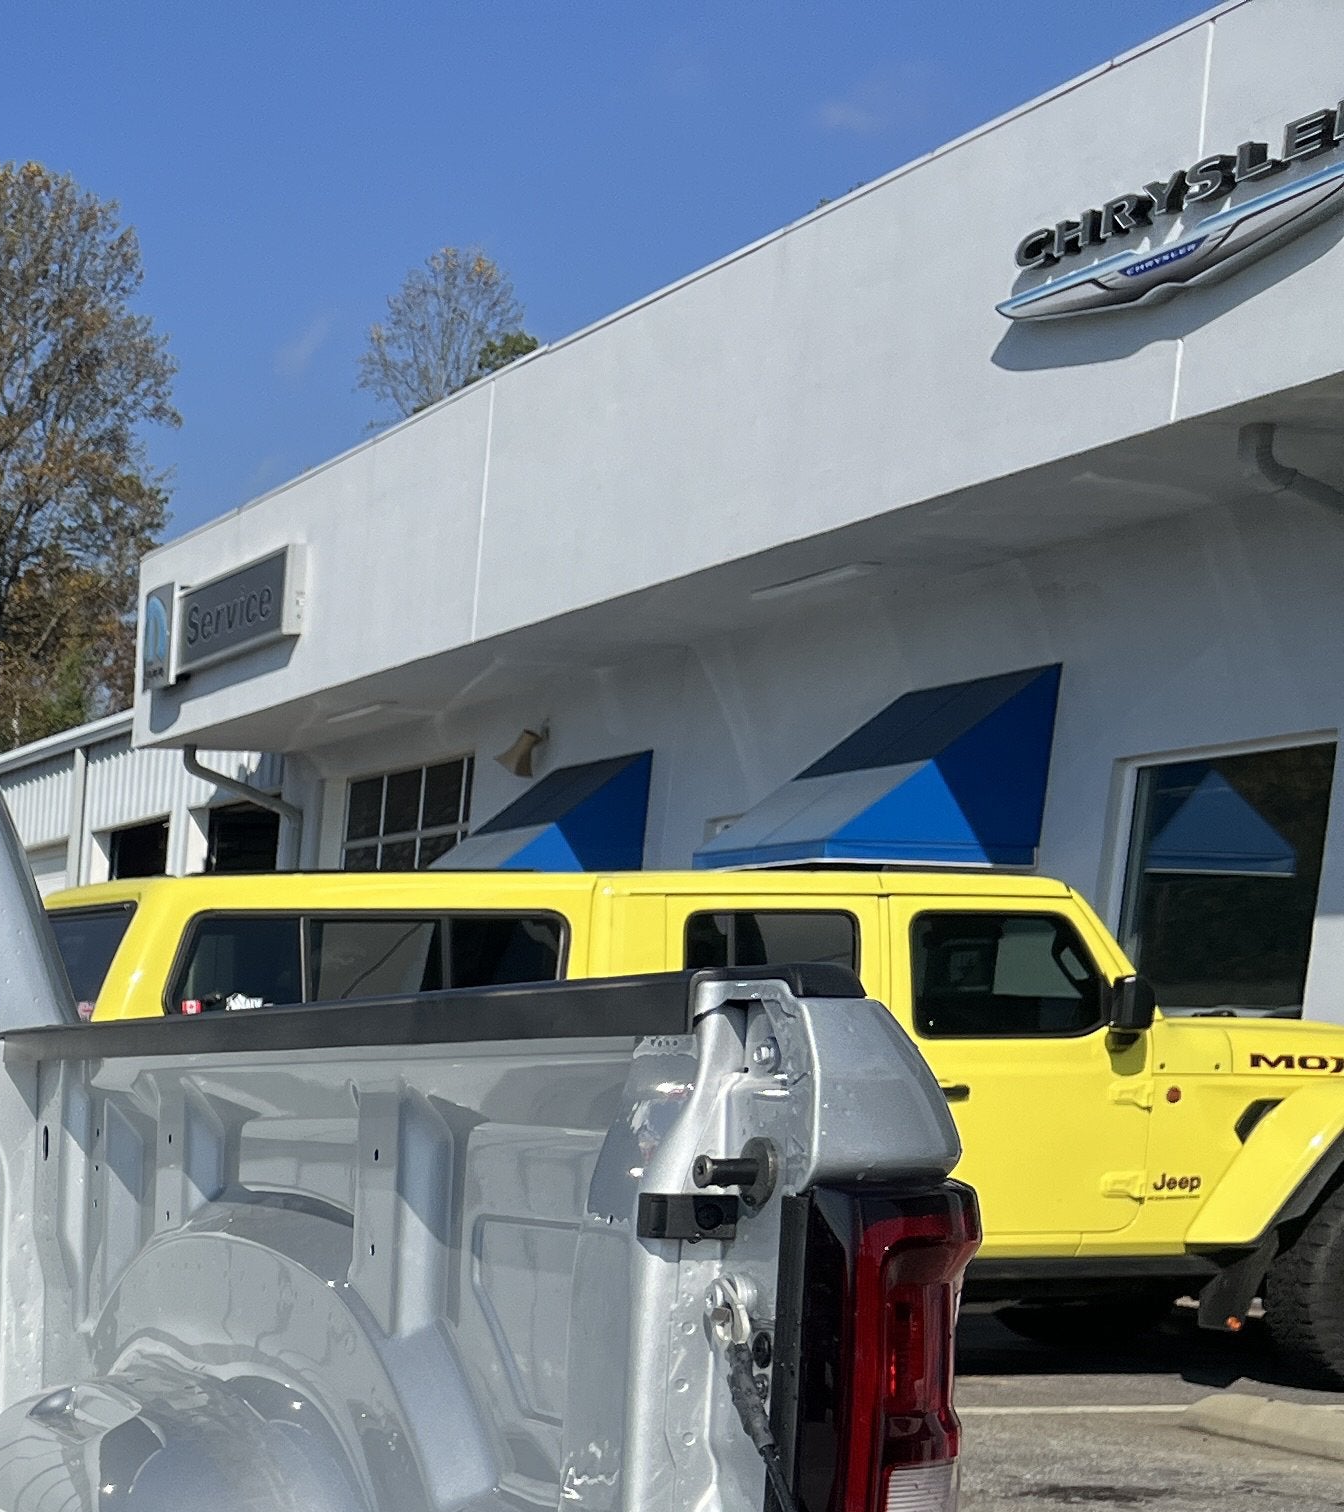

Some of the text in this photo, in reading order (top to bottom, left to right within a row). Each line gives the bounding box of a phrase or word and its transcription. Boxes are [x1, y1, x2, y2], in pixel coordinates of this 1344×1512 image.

[1015, 99, 1344, 270] CHRYSLE
[187, 585, 272, 647] Service
[1152, 1172, 1202, 1193] Jeep
